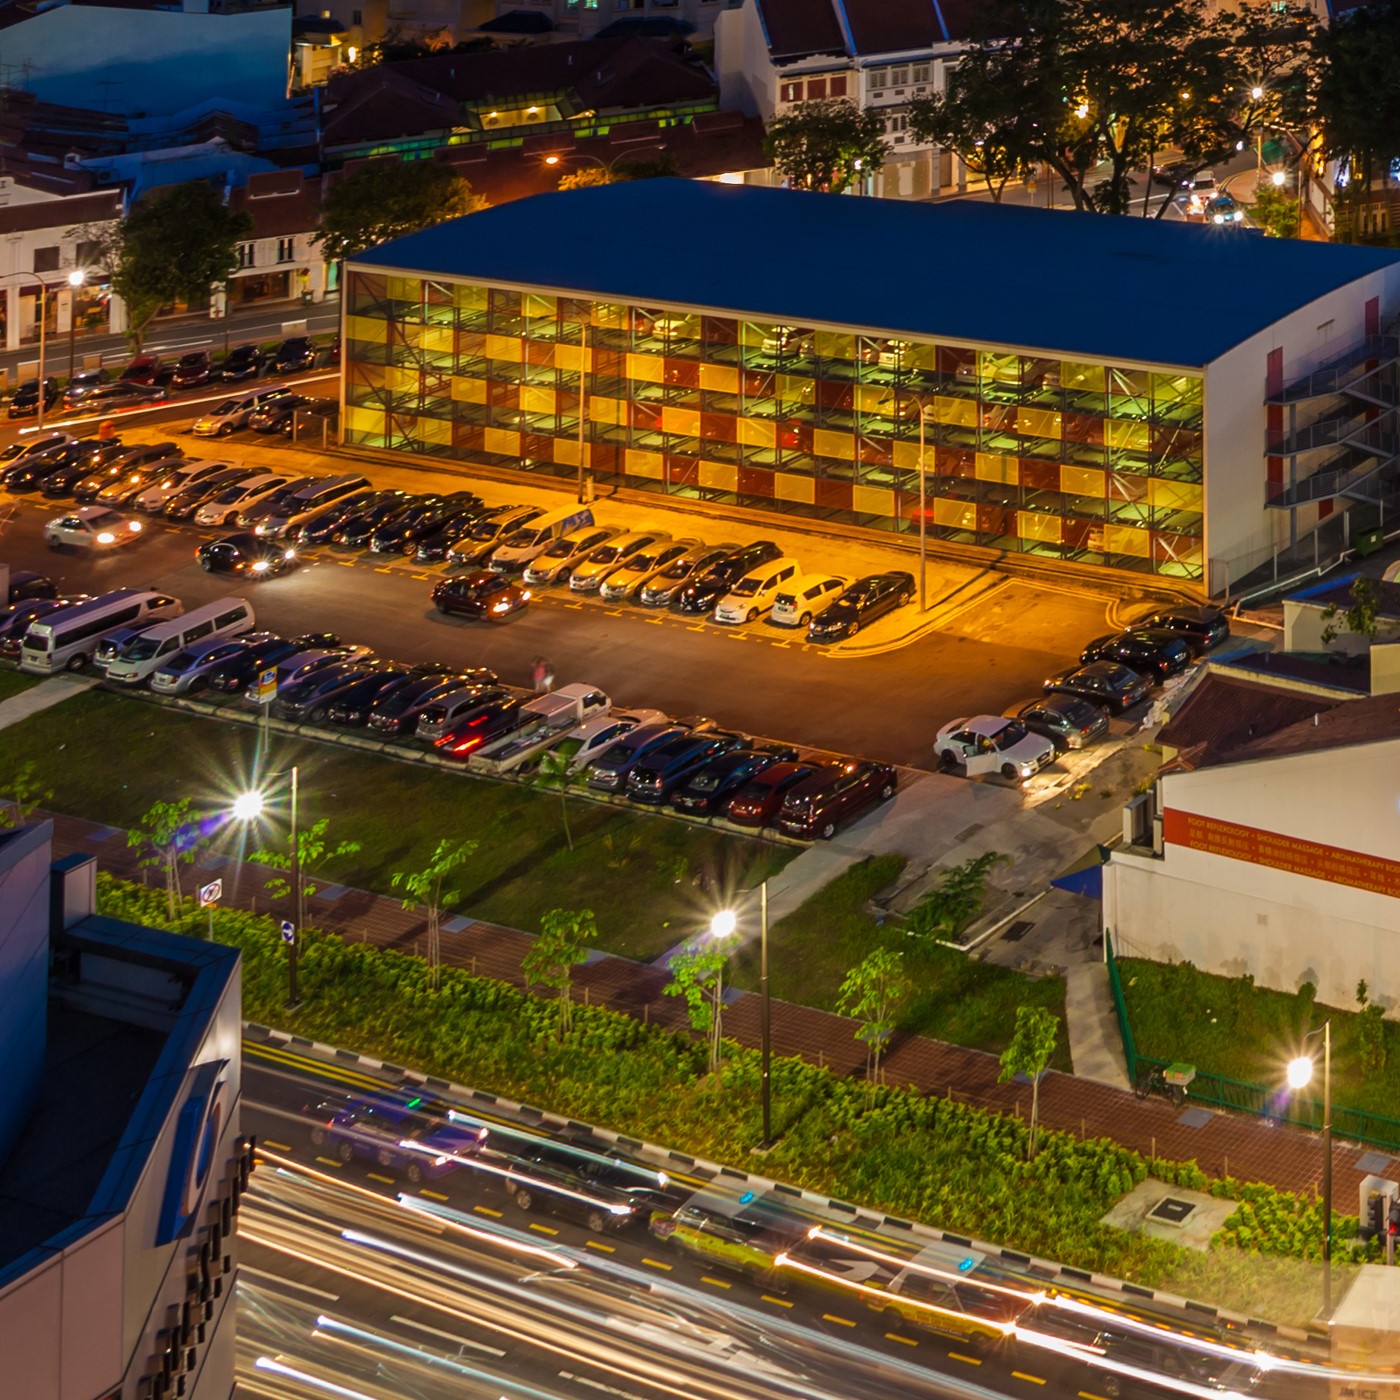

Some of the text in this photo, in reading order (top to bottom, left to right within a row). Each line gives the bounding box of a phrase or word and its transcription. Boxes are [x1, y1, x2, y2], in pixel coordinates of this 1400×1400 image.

[1188, 817, 1206, 827] FOOT
[1206, 822, 1250, 838] REFLEXOLOGY
[1256, 833, 1290, 848] SHOULDER
[1291, 842, 1324, 856] MASSAGE
[1331, 851, 1385, 870] AROMATHERAPY
[1190, 841, 1208, 851] FOOT
[1208, 845, 1252, 861] REFLEXOLOGY
[1259, 856, 1293, 871] SHOULDER
[1293, 865, 1326, 880] MASSAGE
[1333, 875, 1387, 894] AROMATHERAPY
[1358, 1388, 1378, 1400] ICE
